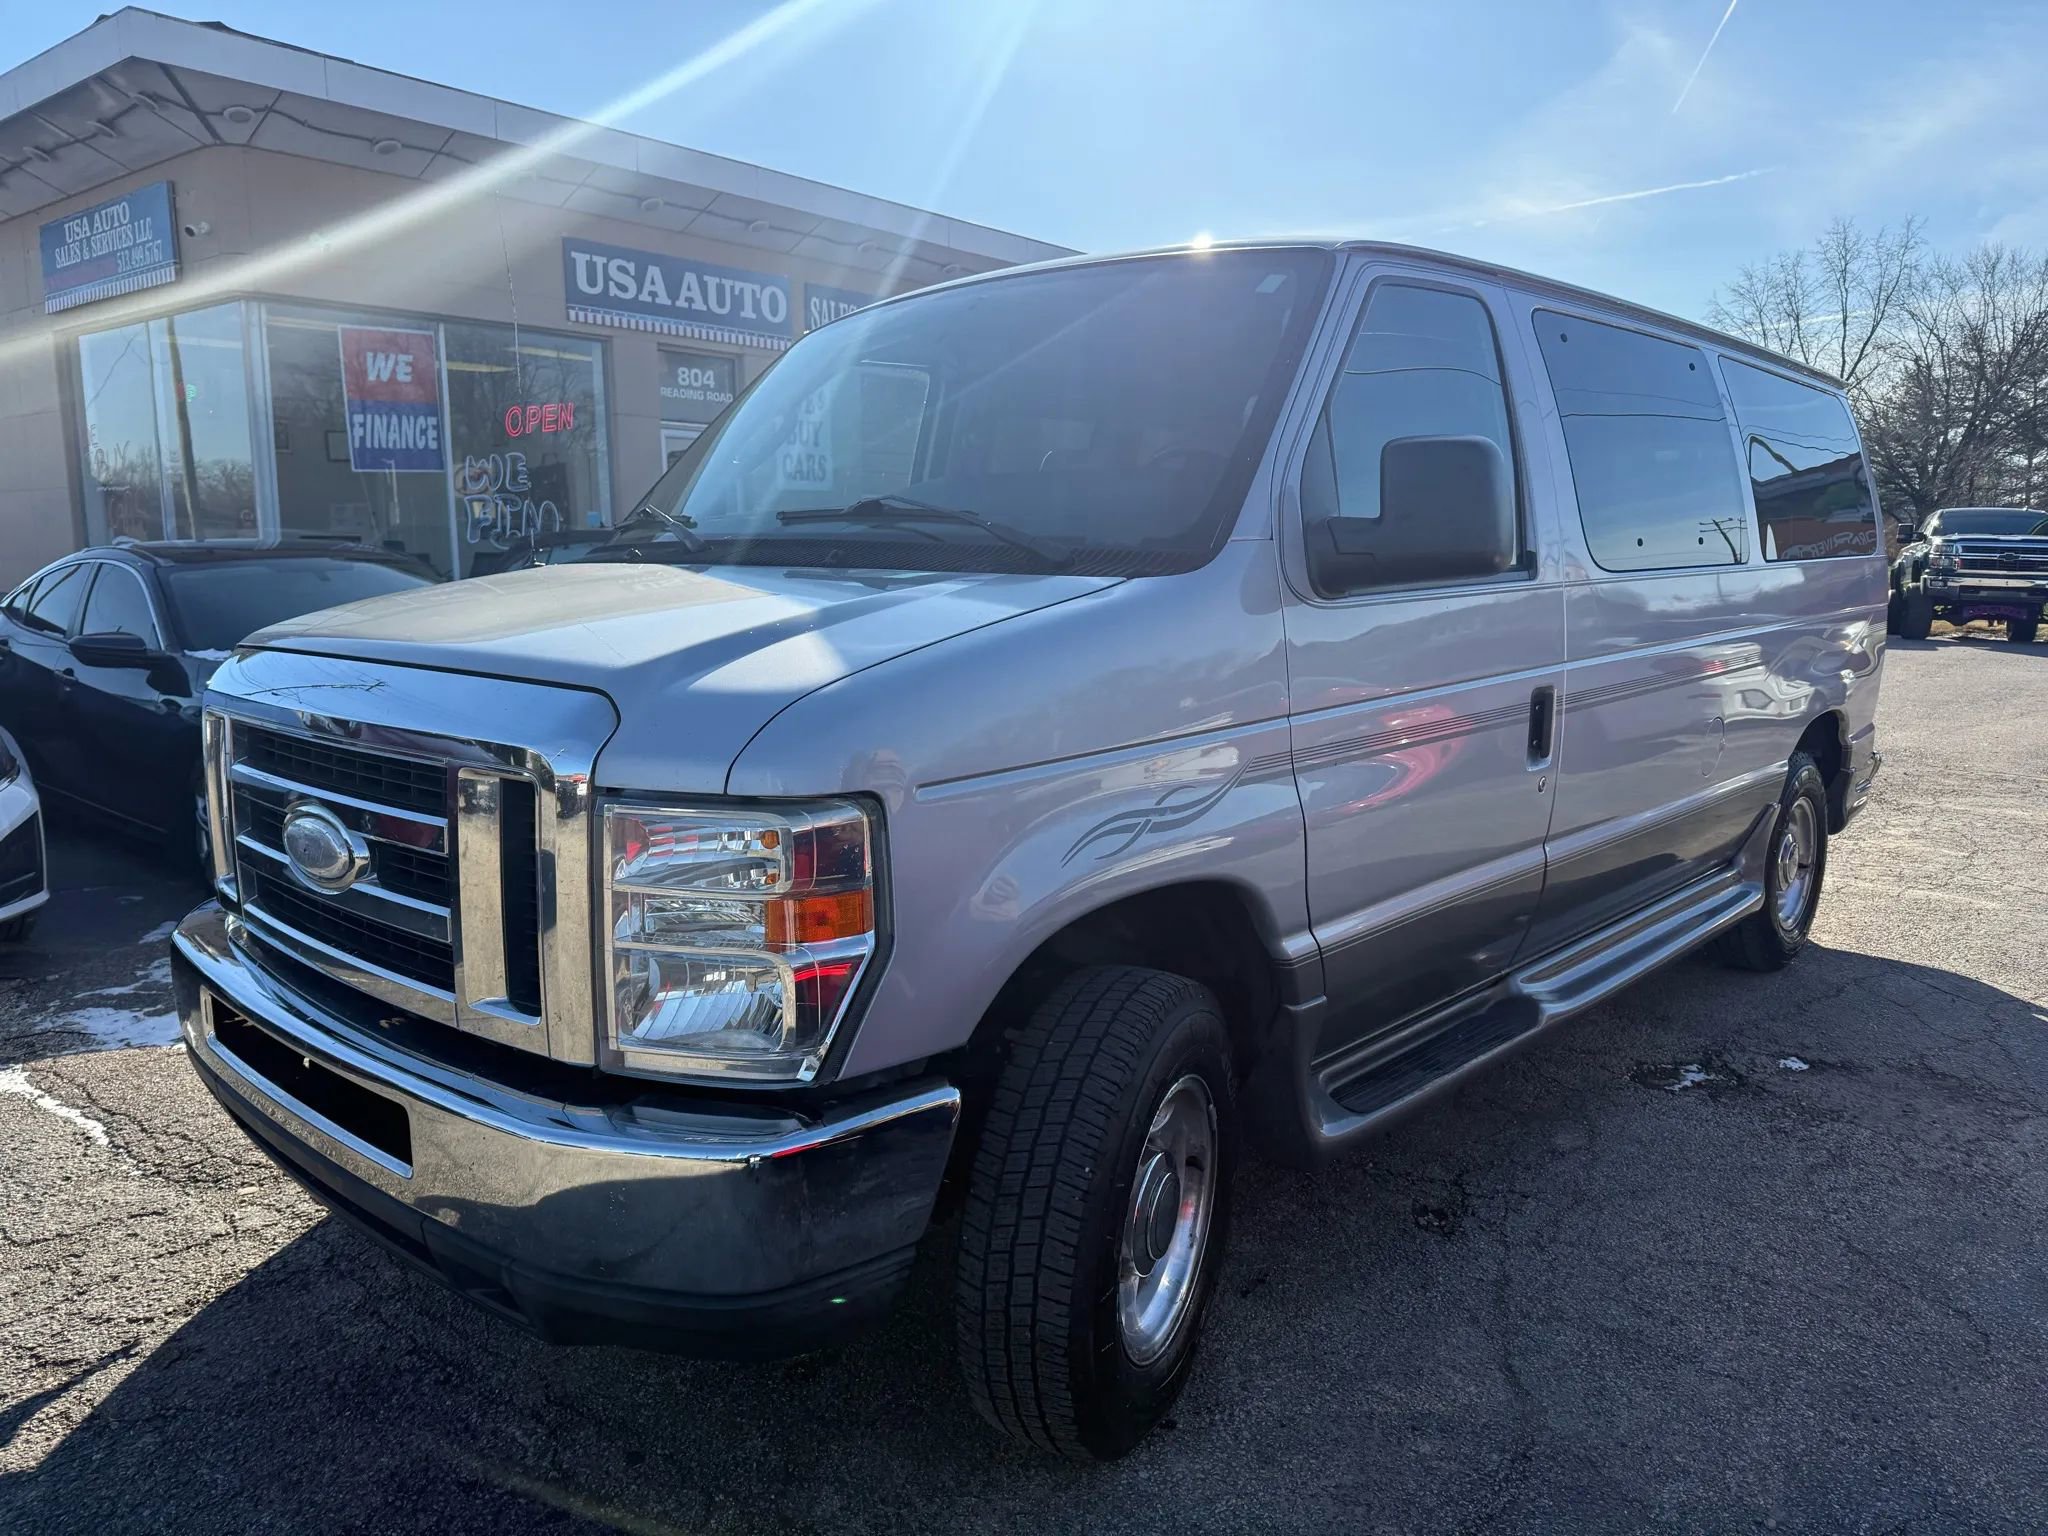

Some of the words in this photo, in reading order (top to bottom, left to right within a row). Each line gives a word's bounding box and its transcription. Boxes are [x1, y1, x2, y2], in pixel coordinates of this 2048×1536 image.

[64, 216, 91, 244] USA
[93, 201, 130, 234] AUTO
[55, 241, 81, 268] SALES
[83, 239, 90, 260] &
[91, 223, 134, 258] SERVICES
[134, 217, 153, 244] LLC
[571, 251, 672, 306] USA
[675, 271, 787, 323] AUTO
[811, 297, 857, 330] SAL
[366, 352, 413, 383] WE
[678, 367, 715, 389] 804
[660, 387, 704, 401] READING
[706, 391, 733, 403] ROAD
[352, 412, 438, 450] FINANCE
[505, 402, 574, 438] OPEN
[465, 452, 530, 492] WE
[782, 453, 826, 482] CARS
